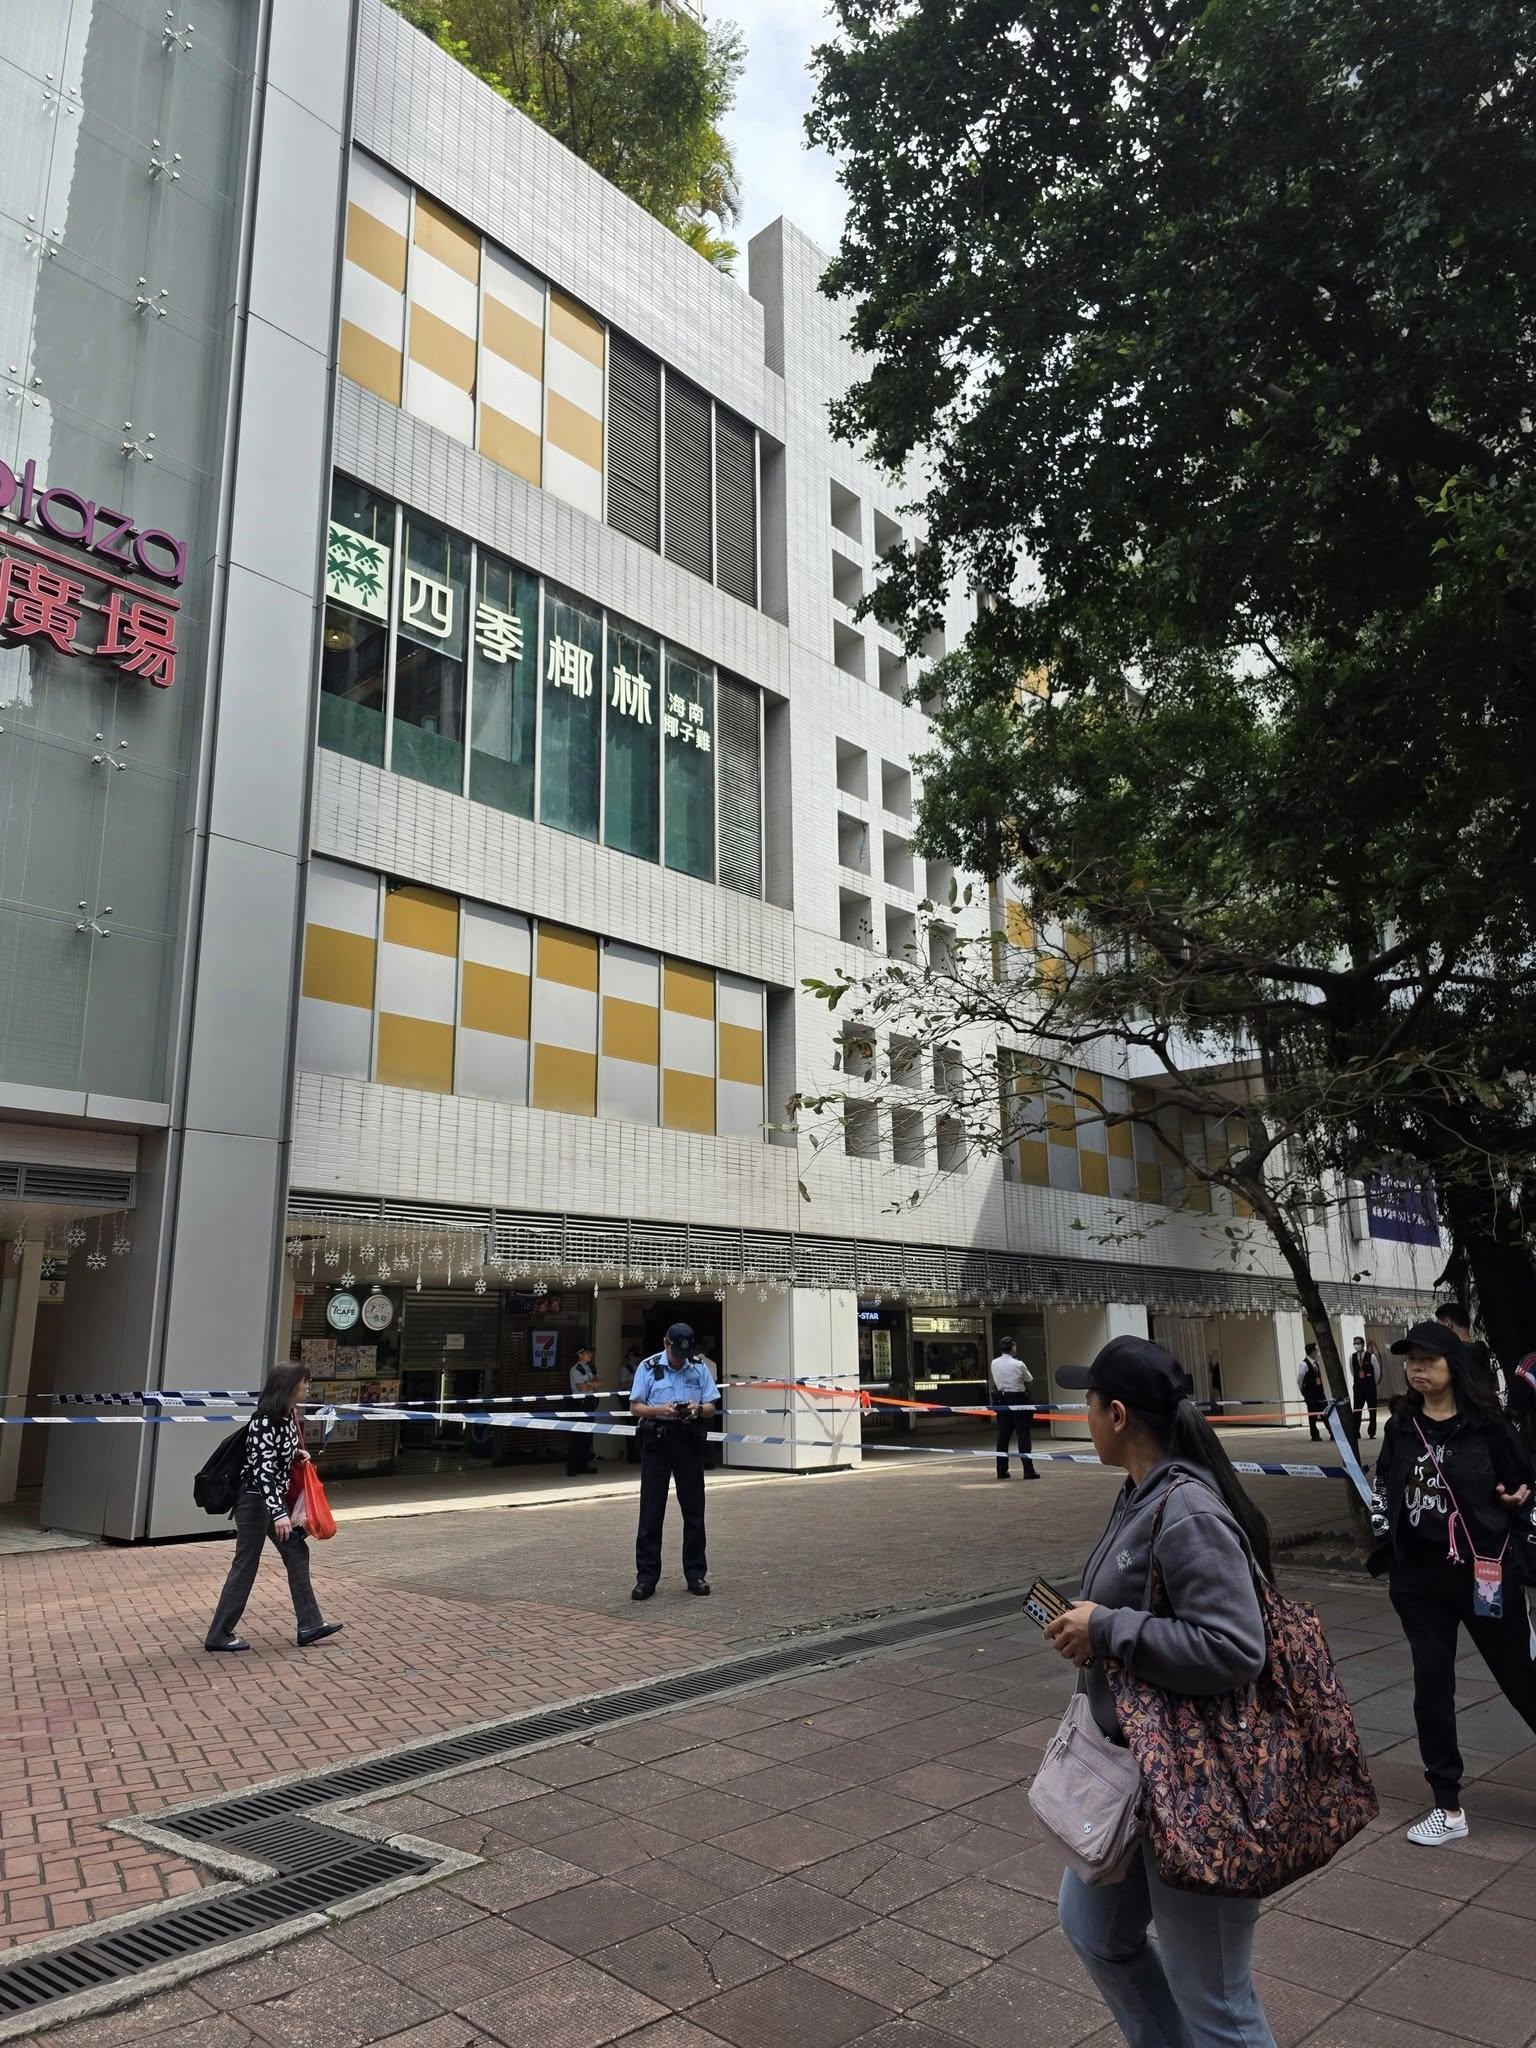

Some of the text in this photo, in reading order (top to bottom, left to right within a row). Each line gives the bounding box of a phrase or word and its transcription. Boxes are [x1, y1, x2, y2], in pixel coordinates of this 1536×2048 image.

[0, 556, 179, 688] 廣場
[403, 569, 652, 724] 四季椰林
[667, 691, 704, 726] 海南
[49, 1282, 59, 1296] 8
